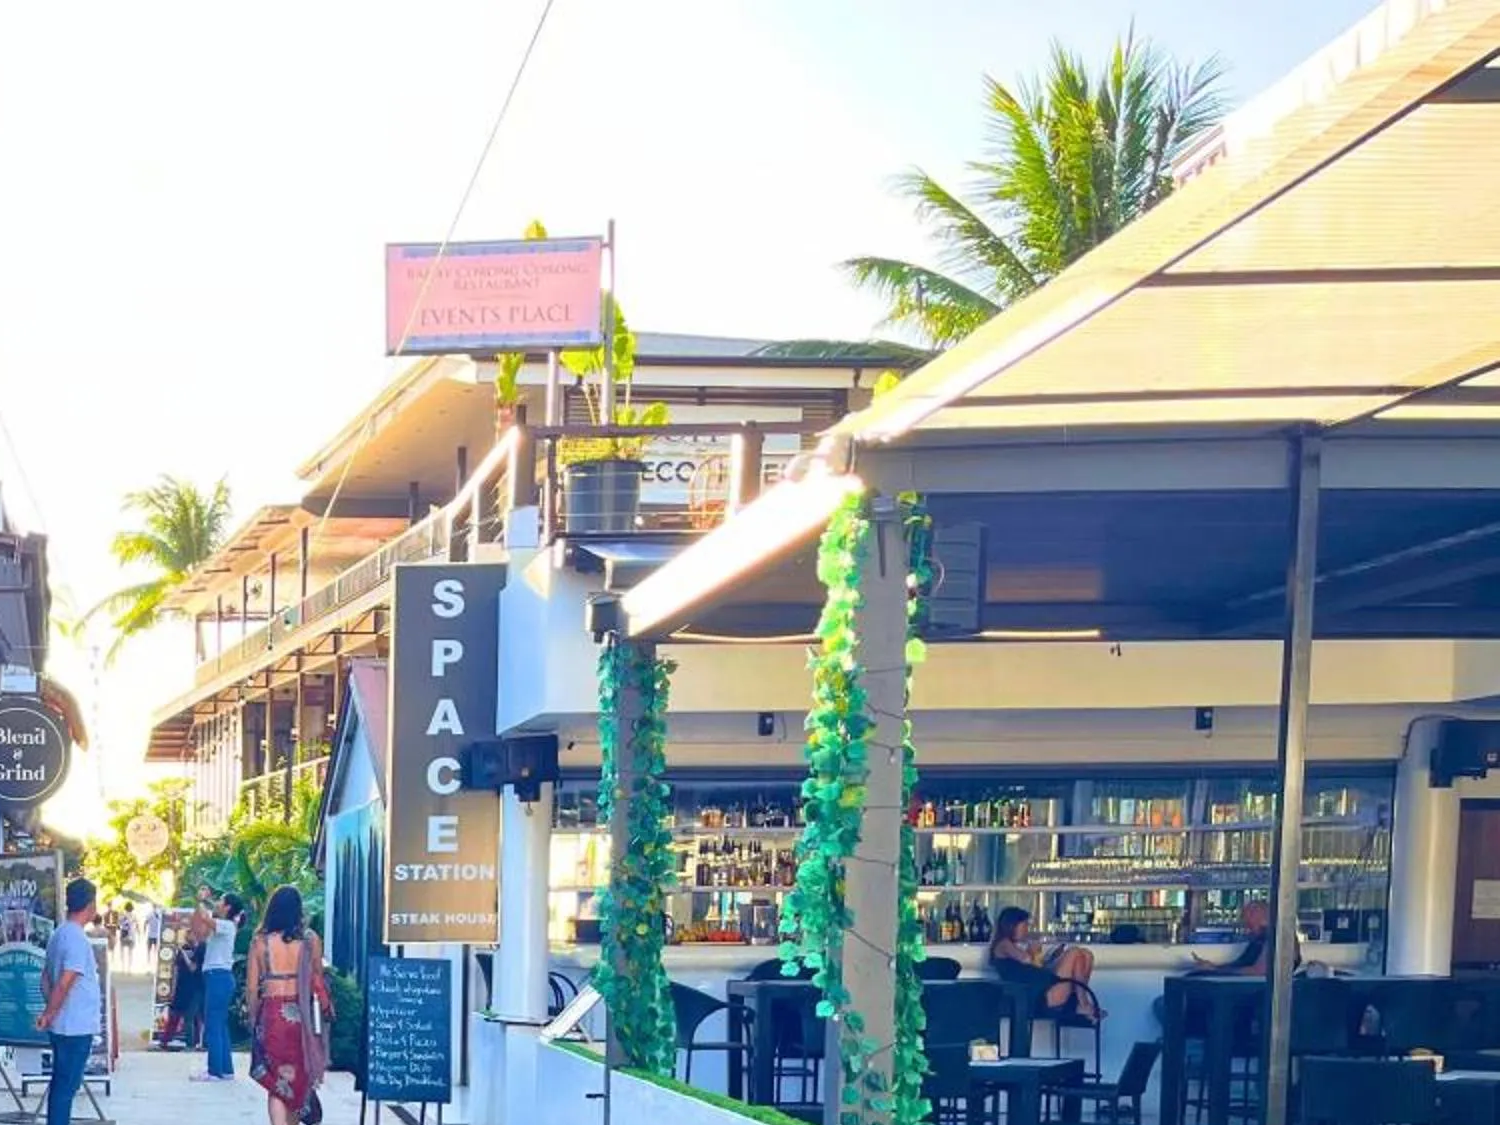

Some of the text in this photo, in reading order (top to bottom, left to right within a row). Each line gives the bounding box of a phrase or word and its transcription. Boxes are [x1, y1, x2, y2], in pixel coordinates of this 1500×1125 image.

[453, 277, 541, 290] RESTAURANT
[420, 302, 575, 328] EVENTS PLACE
[426, 578, 466, 854] SPACE
[394, 863, 495, 881] STATION
[390, 911, 497, 925] STEAK HOUSE
